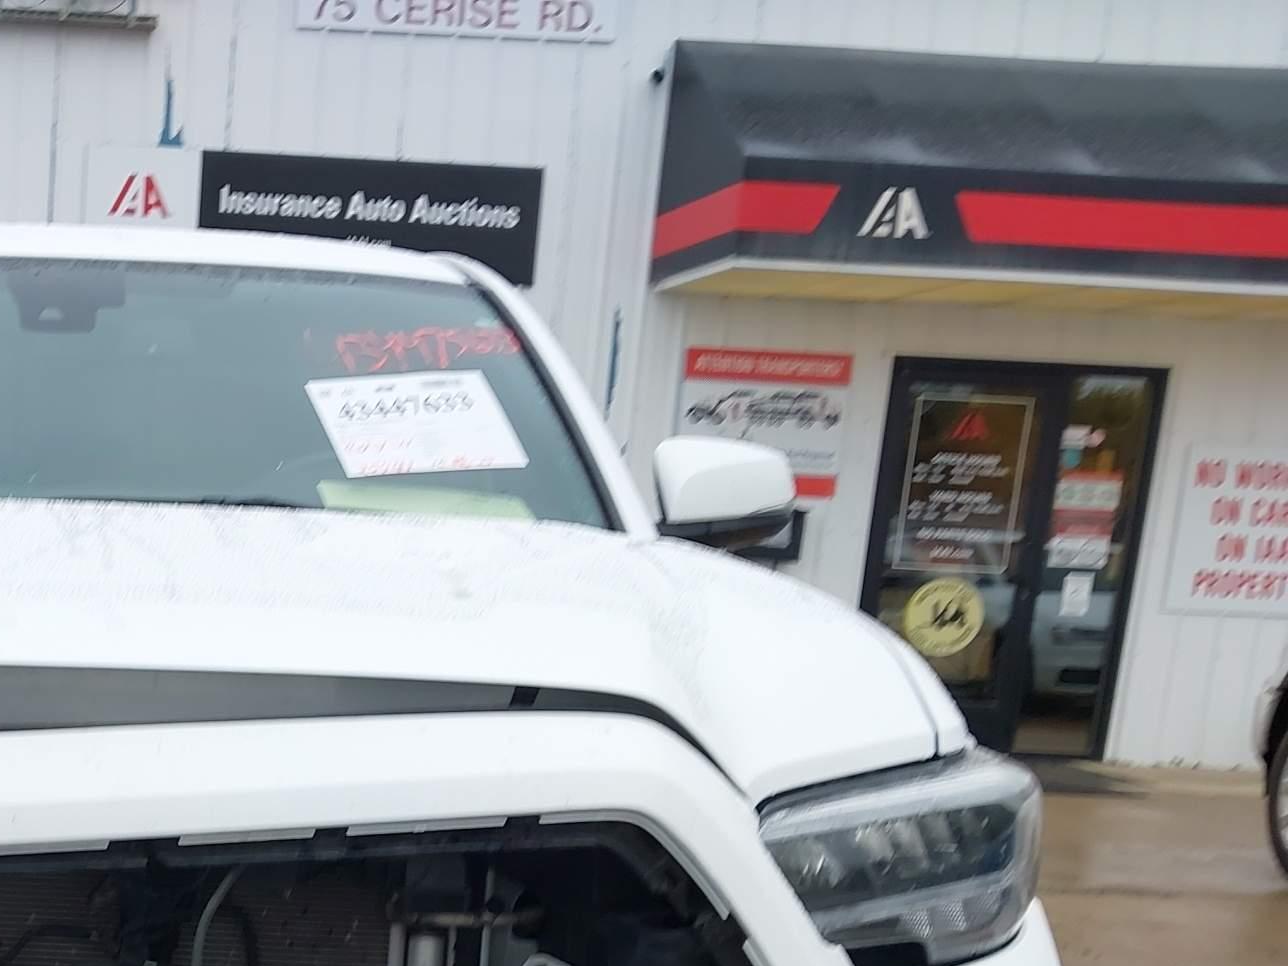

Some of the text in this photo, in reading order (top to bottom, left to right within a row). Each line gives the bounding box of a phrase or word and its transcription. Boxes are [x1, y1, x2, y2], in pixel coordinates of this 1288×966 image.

[375, 0, 519, 29] CERISE
[539, 0, 602, 33] RD.
[218, 183, 521, 229] Insurance Auto Auctions
[1194, 461, 1288, 490] NO WOR
[1210, 497, 1241, 526] ON
[1216, 533, 1247, 562] ON
[1192, 569, 1288, 600] PROPERT
